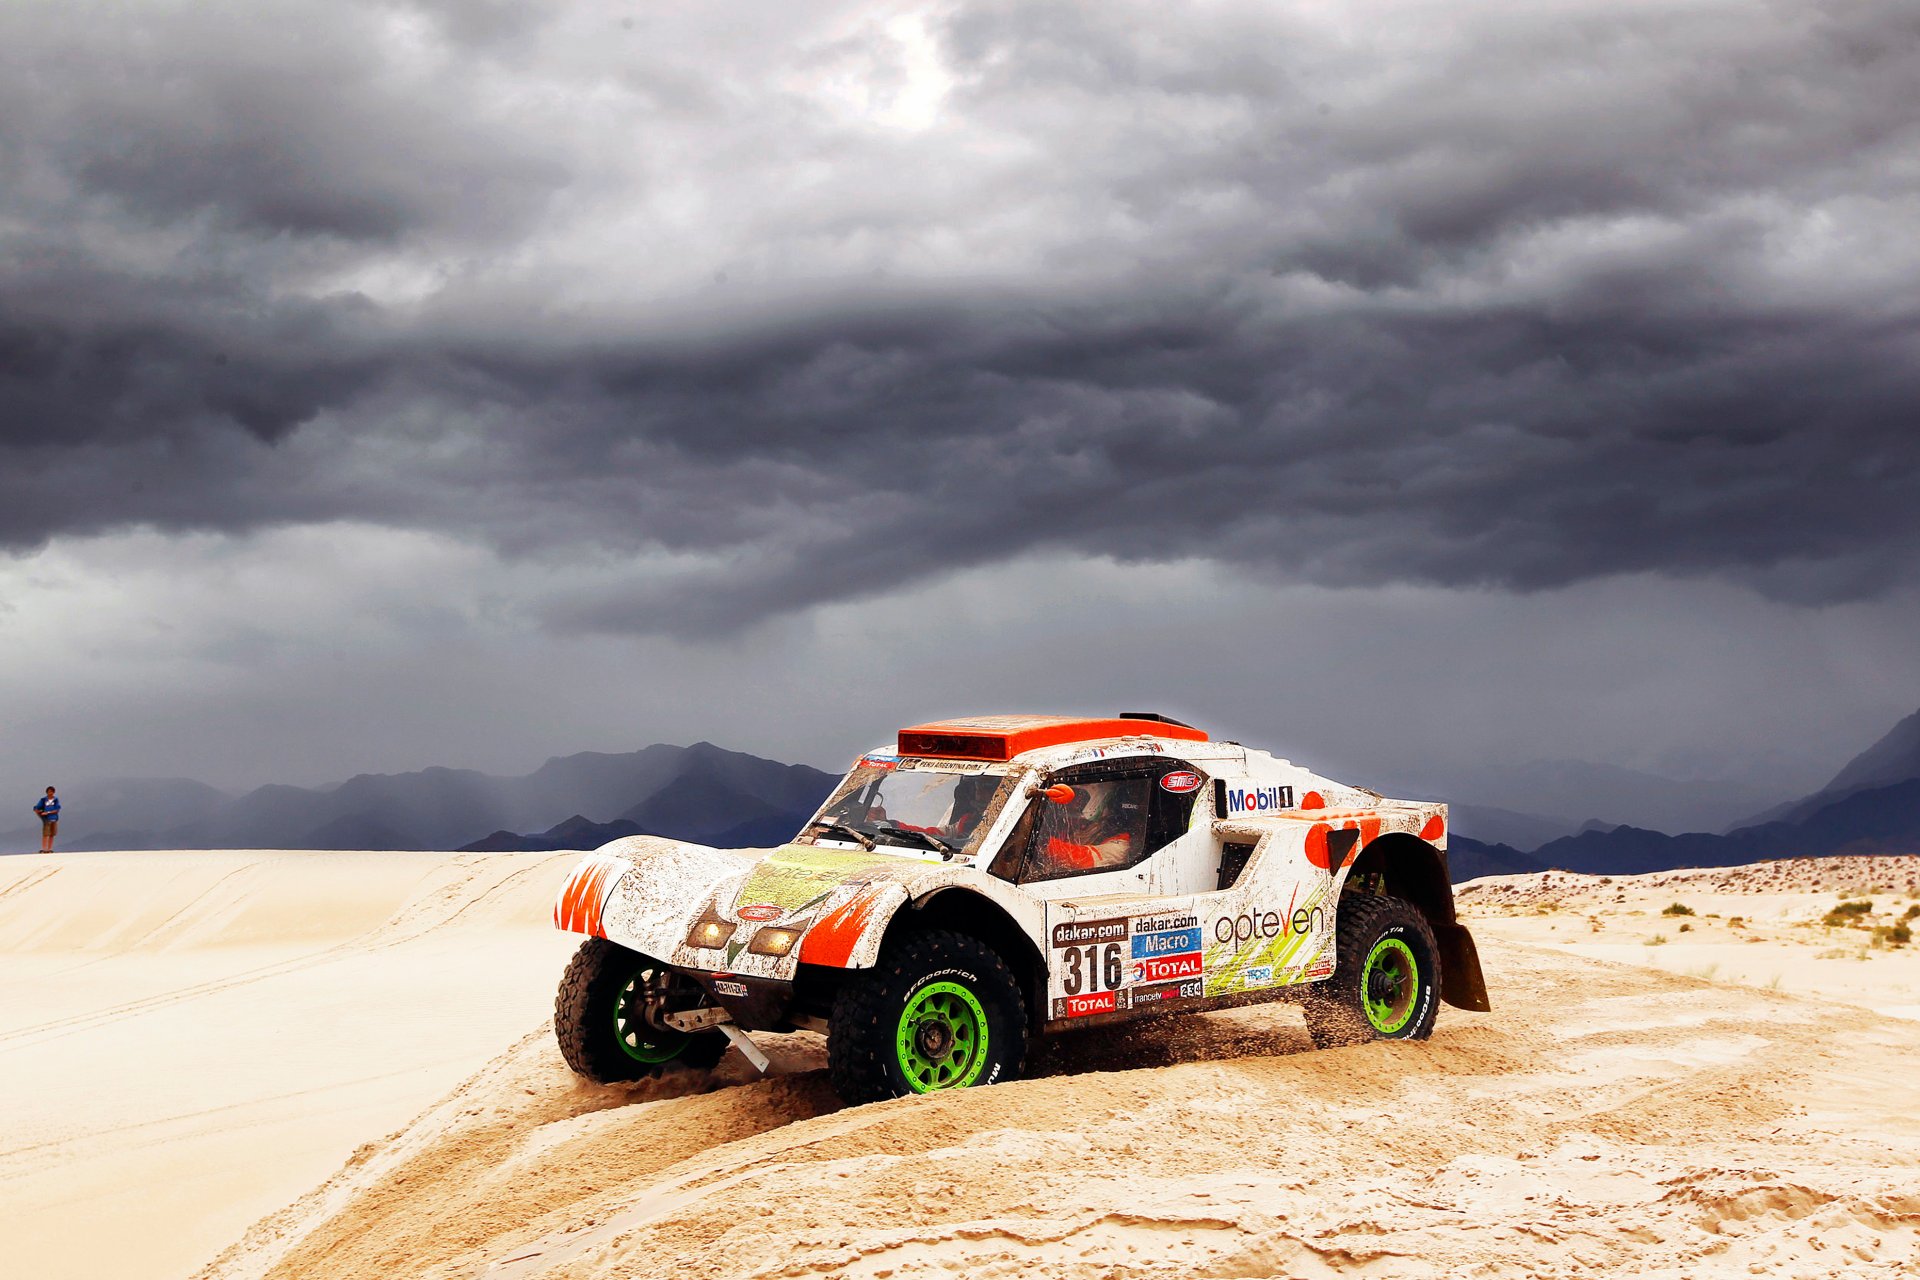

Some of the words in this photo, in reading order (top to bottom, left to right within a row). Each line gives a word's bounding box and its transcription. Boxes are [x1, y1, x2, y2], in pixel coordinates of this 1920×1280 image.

[1229, 787, 1277, 812] Mobil
[1136, 916, 1198, 933] dakar.com
[1215, 881, 1325, 952] opteven
[1056, 924, 1125, 942] dakar.com
[1145, 935, 1189, 953] Macro
[1063, 942, 1123, 996] 316
[1148, 959, 1200, 978] TOTAL
[903, 967, 978, 1003] BFGoodrich
[1069, 997, 1113, 1013] TOTAL
